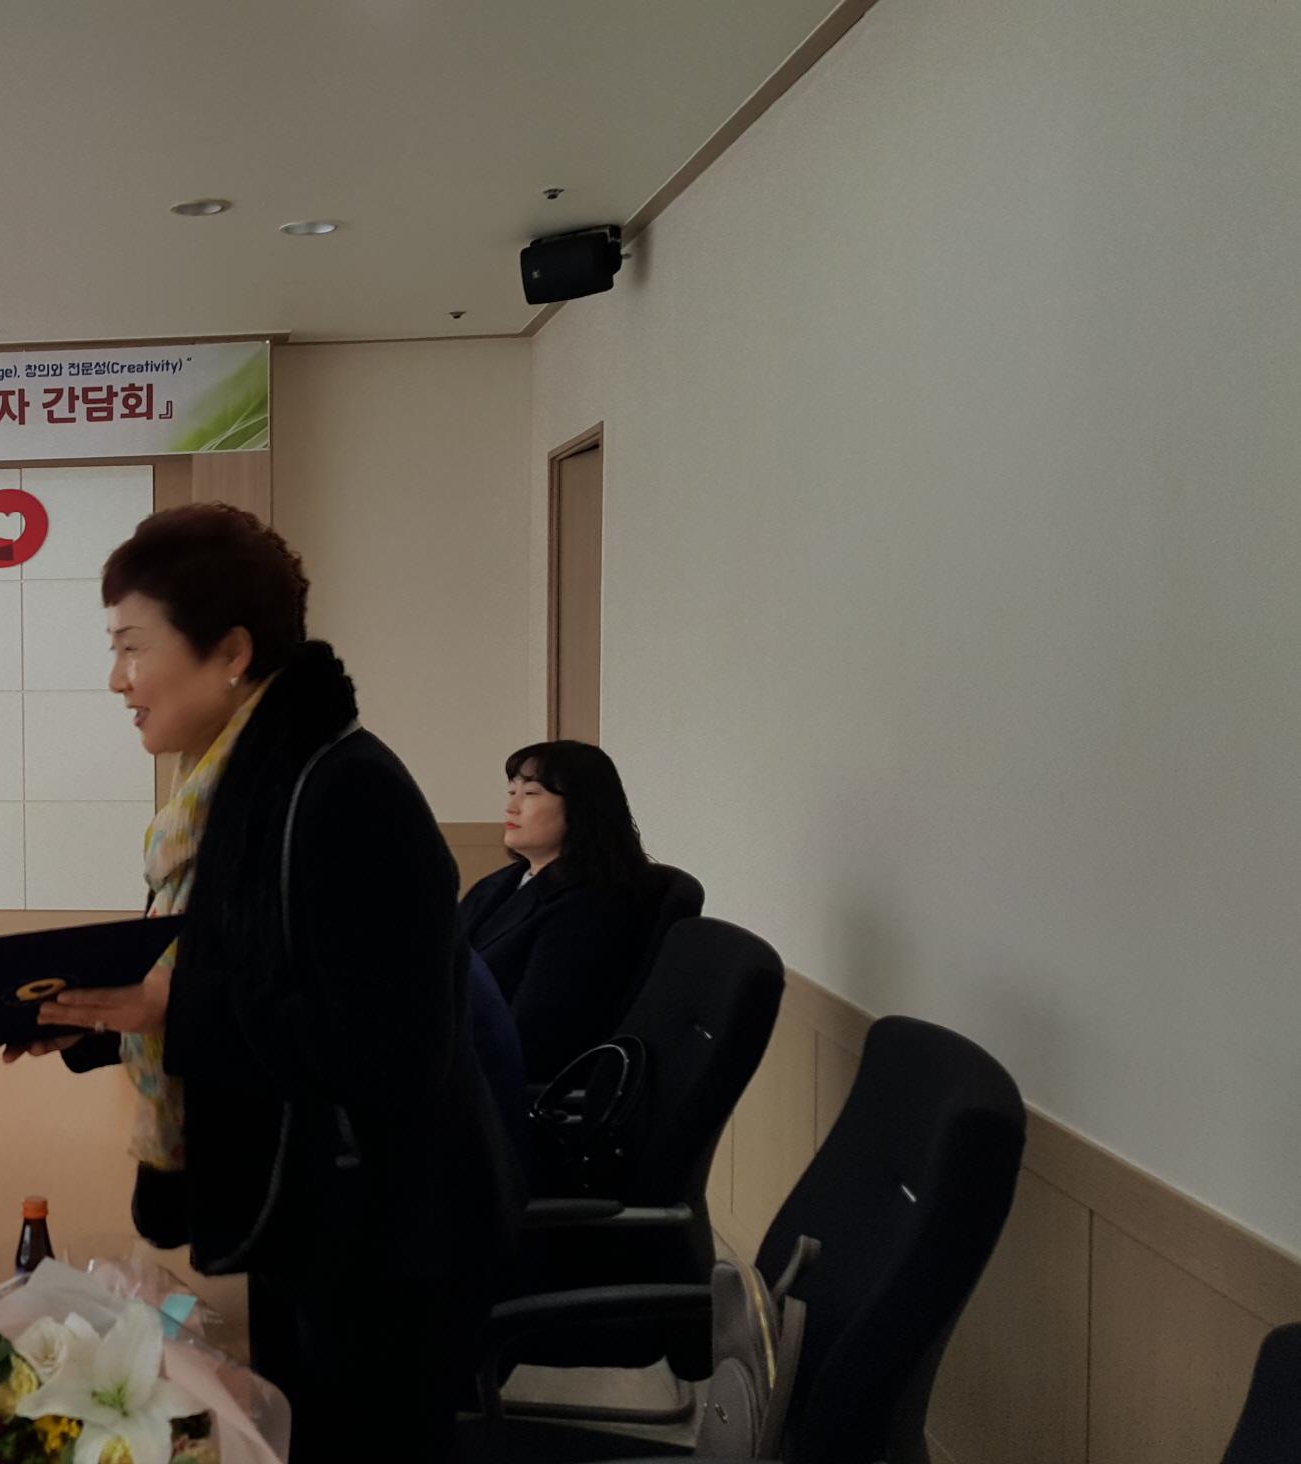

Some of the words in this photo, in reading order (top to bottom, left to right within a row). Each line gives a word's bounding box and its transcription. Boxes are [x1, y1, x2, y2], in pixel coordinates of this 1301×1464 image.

[25, 362, 63, 378] 창의와
[68, 358, 183, 376] 전문성(Creativity)
[41, 382, 173, 424] 간담회』
